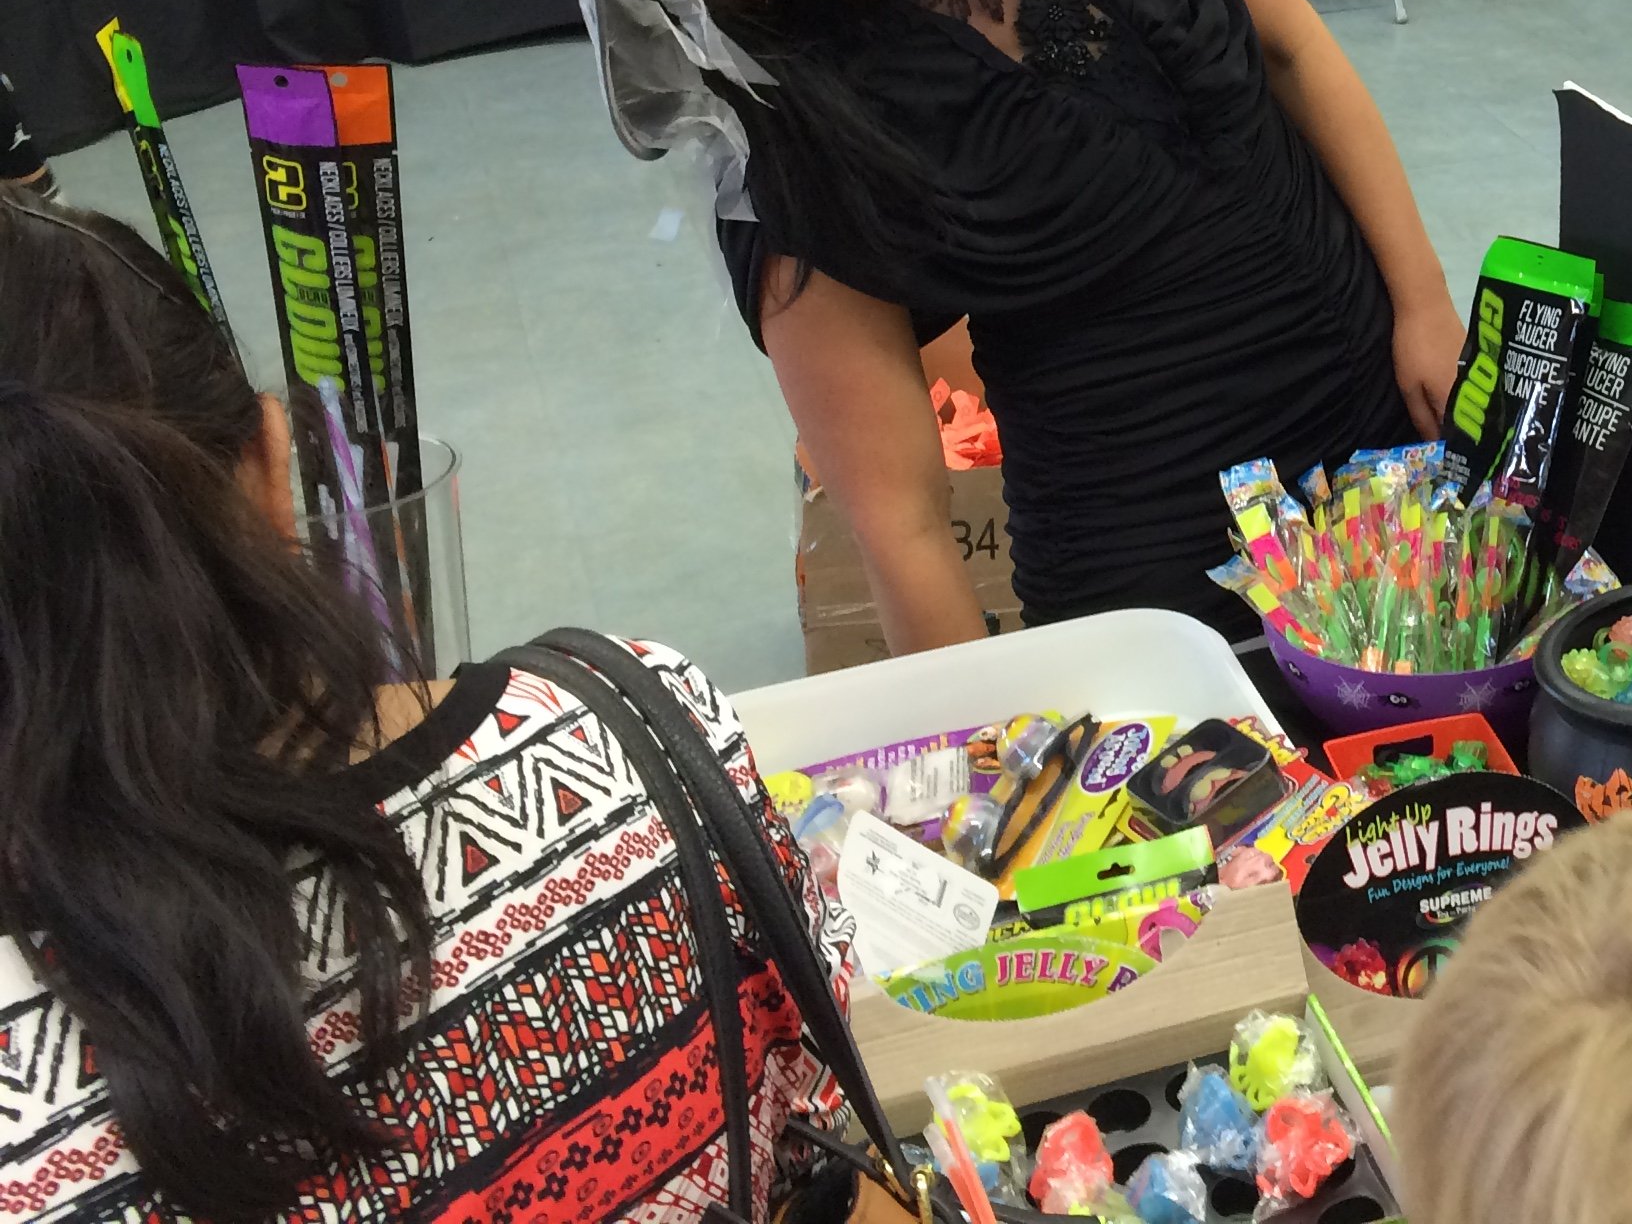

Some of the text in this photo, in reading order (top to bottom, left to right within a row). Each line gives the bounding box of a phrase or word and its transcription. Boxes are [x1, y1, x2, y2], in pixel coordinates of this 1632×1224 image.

[319, 161, 346, 224] NECKLACES
[373, 158, 397, 219] NECKLACES
[328, 230, 352, 281] COLLIERS
[271, 223, 346, 393] GLOW
[1518, 299, 1563, 329] FLYING
[1514, 321, 1558, 352] SAUCER
[1452, 287, 1504, 447] GLOW
[1504, 349, 1562, 385] SOUCOUPE
[1586, 364, 1625, 400] UCER
[1343, 801, 1558, 889] Jelly Rings
[1346, 809, 1401, 850] Light
[1406, 801, 1432, 831] Up
[1366, 885, 1391, 904] Fun
[1391, 873, 1435, 896] Designs
[1435, 866, 1452, 886] for
[1419, 886, 1494, 914] SUPREME
[995, 949, 1111, 988] JELLY
